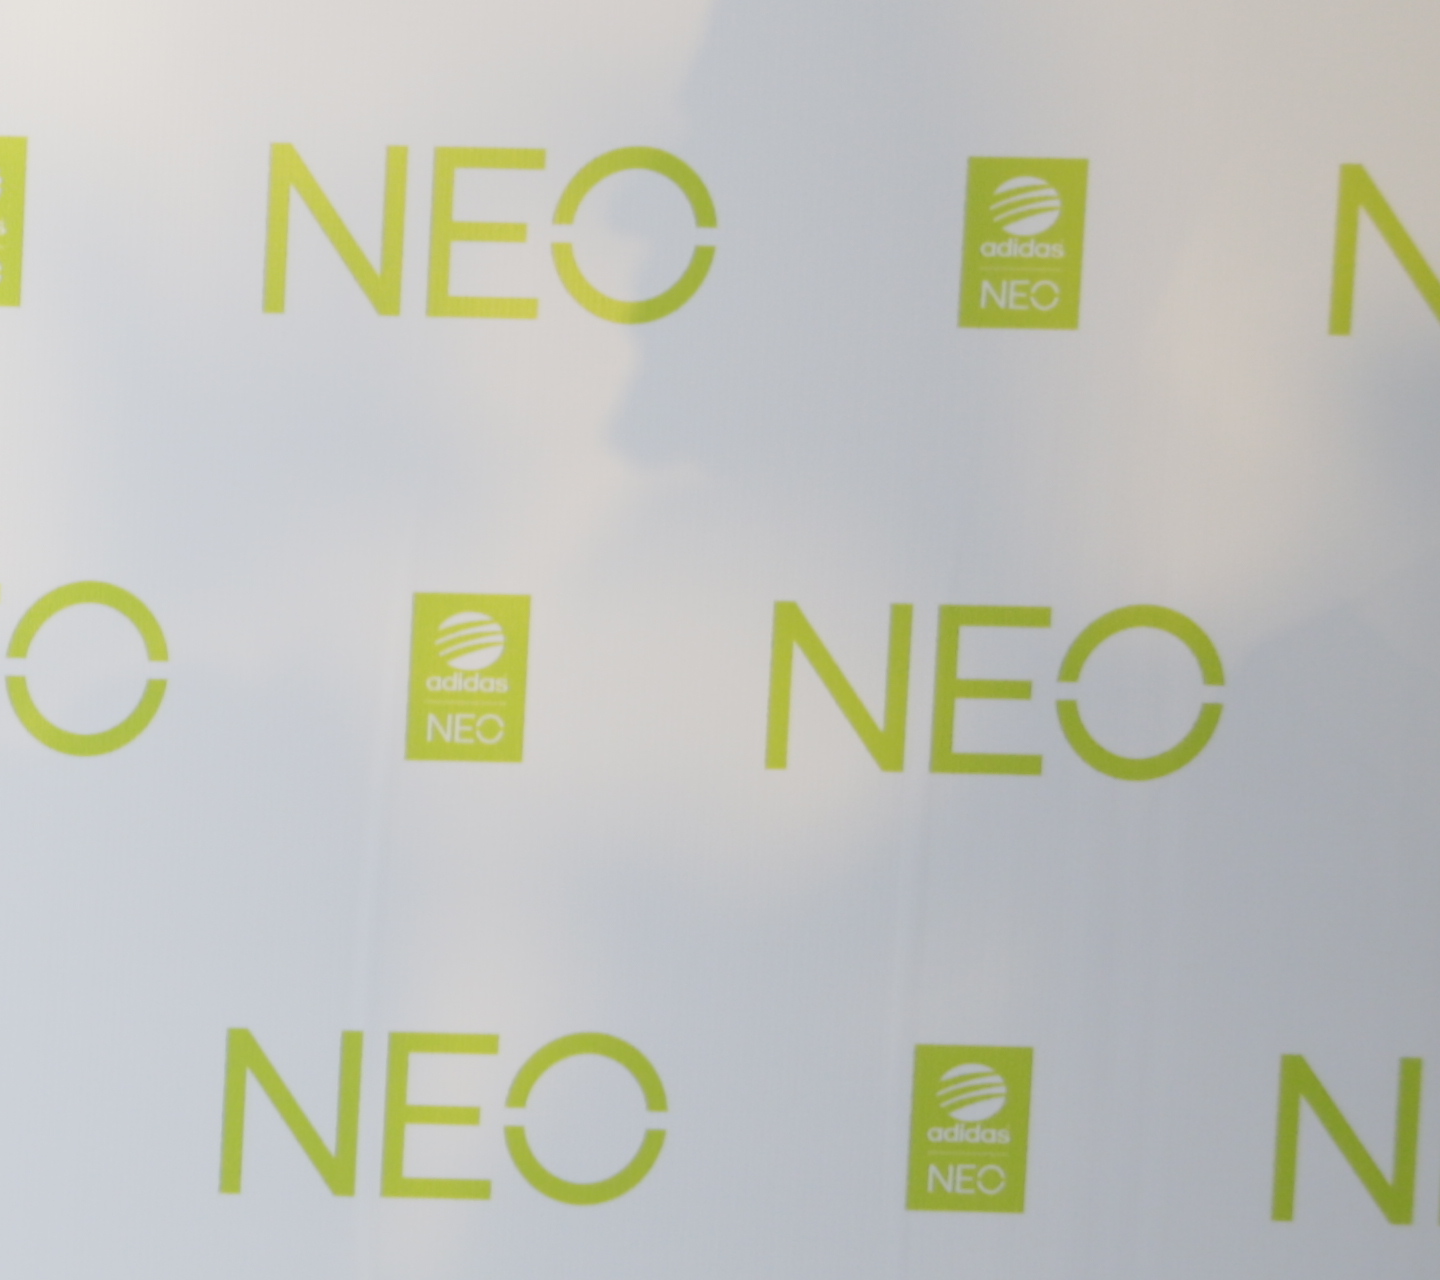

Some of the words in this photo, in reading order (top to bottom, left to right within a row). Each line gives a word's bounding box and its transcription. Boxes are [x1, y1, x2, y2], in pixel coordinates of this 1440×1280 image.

[265, 143, 717, 325] NEO
[979, 237, 1065, 258] adidas
[980, 278, 1061, 312] NEO
[425, 671, 510, 693] adidas
[767, 601, 1225, 781] NEO
[426, 711, 506, 745] NEO
[221, 1028, 668, 1206] NEO
[926, 1122, 1011, 1144] adidas
[926, 1162, 1007, 1196] NEO
